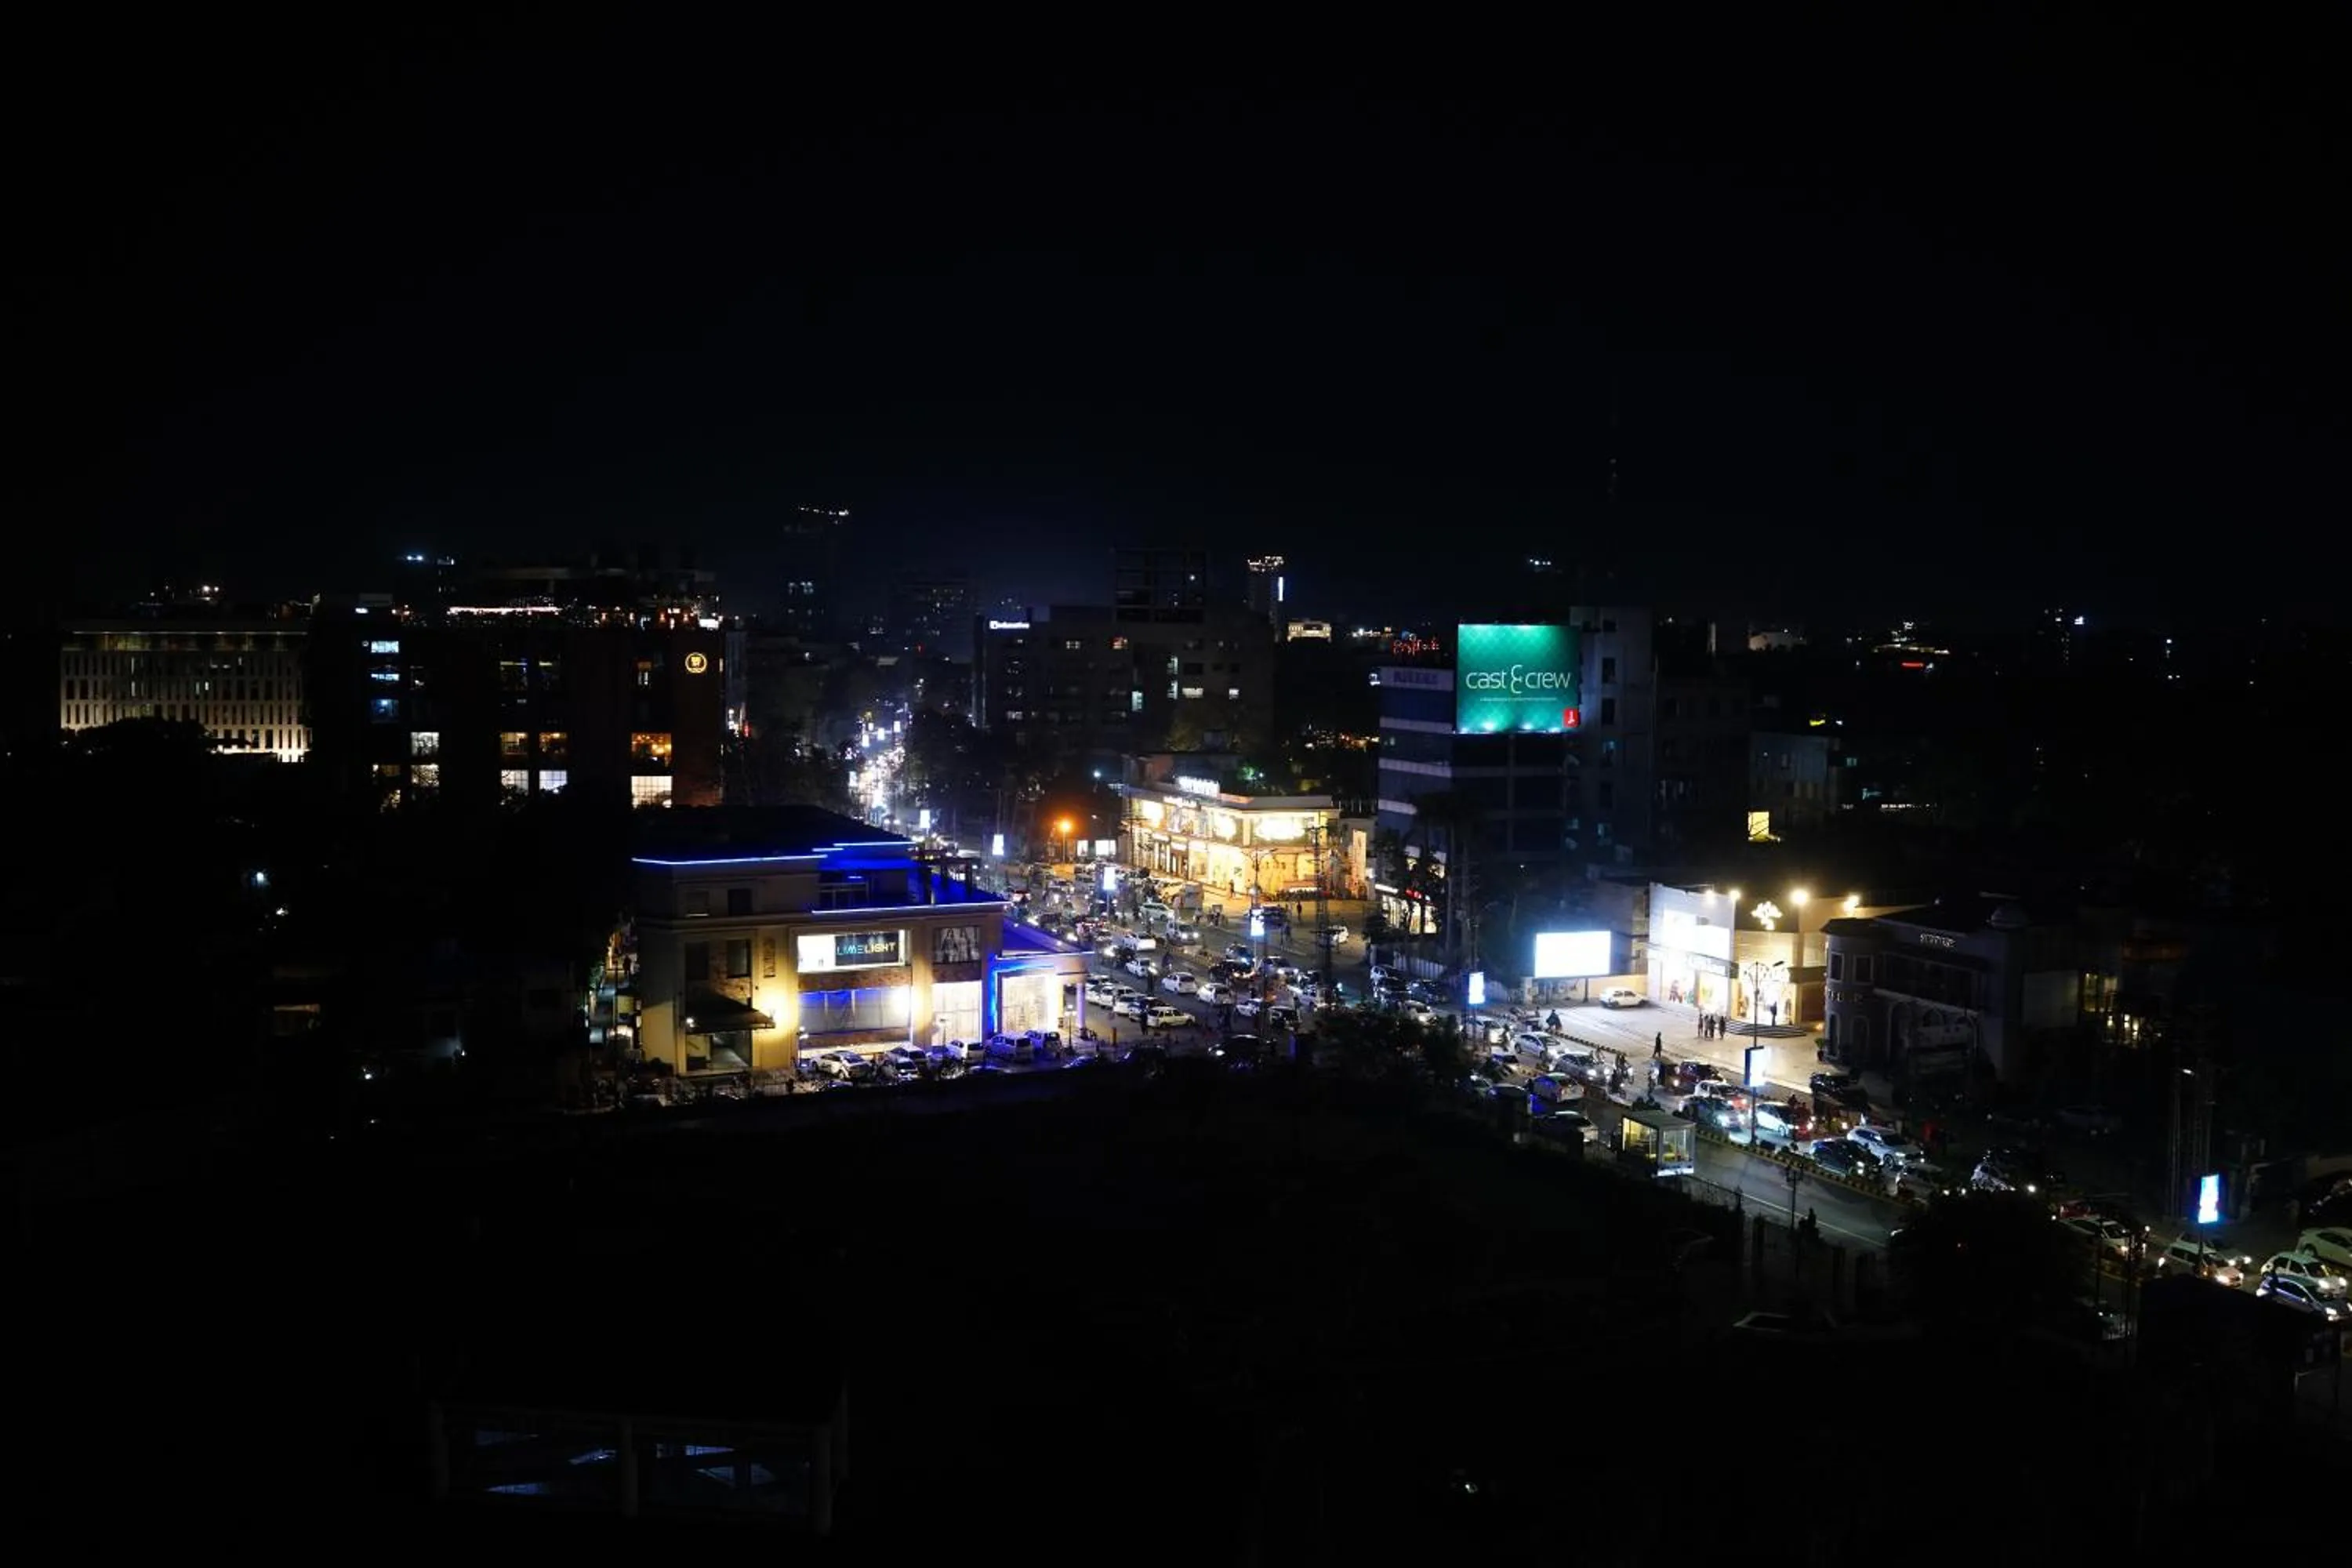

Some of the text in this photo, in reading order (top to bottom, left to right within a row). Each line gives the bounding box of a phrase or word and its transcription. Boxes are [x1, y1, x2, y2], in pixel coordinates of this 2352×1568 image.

[1465, 670, 1507, 689] cast
[1525, 672, 1571, 689] crew
[837, 942, 896, 956] LIMELIGHT
